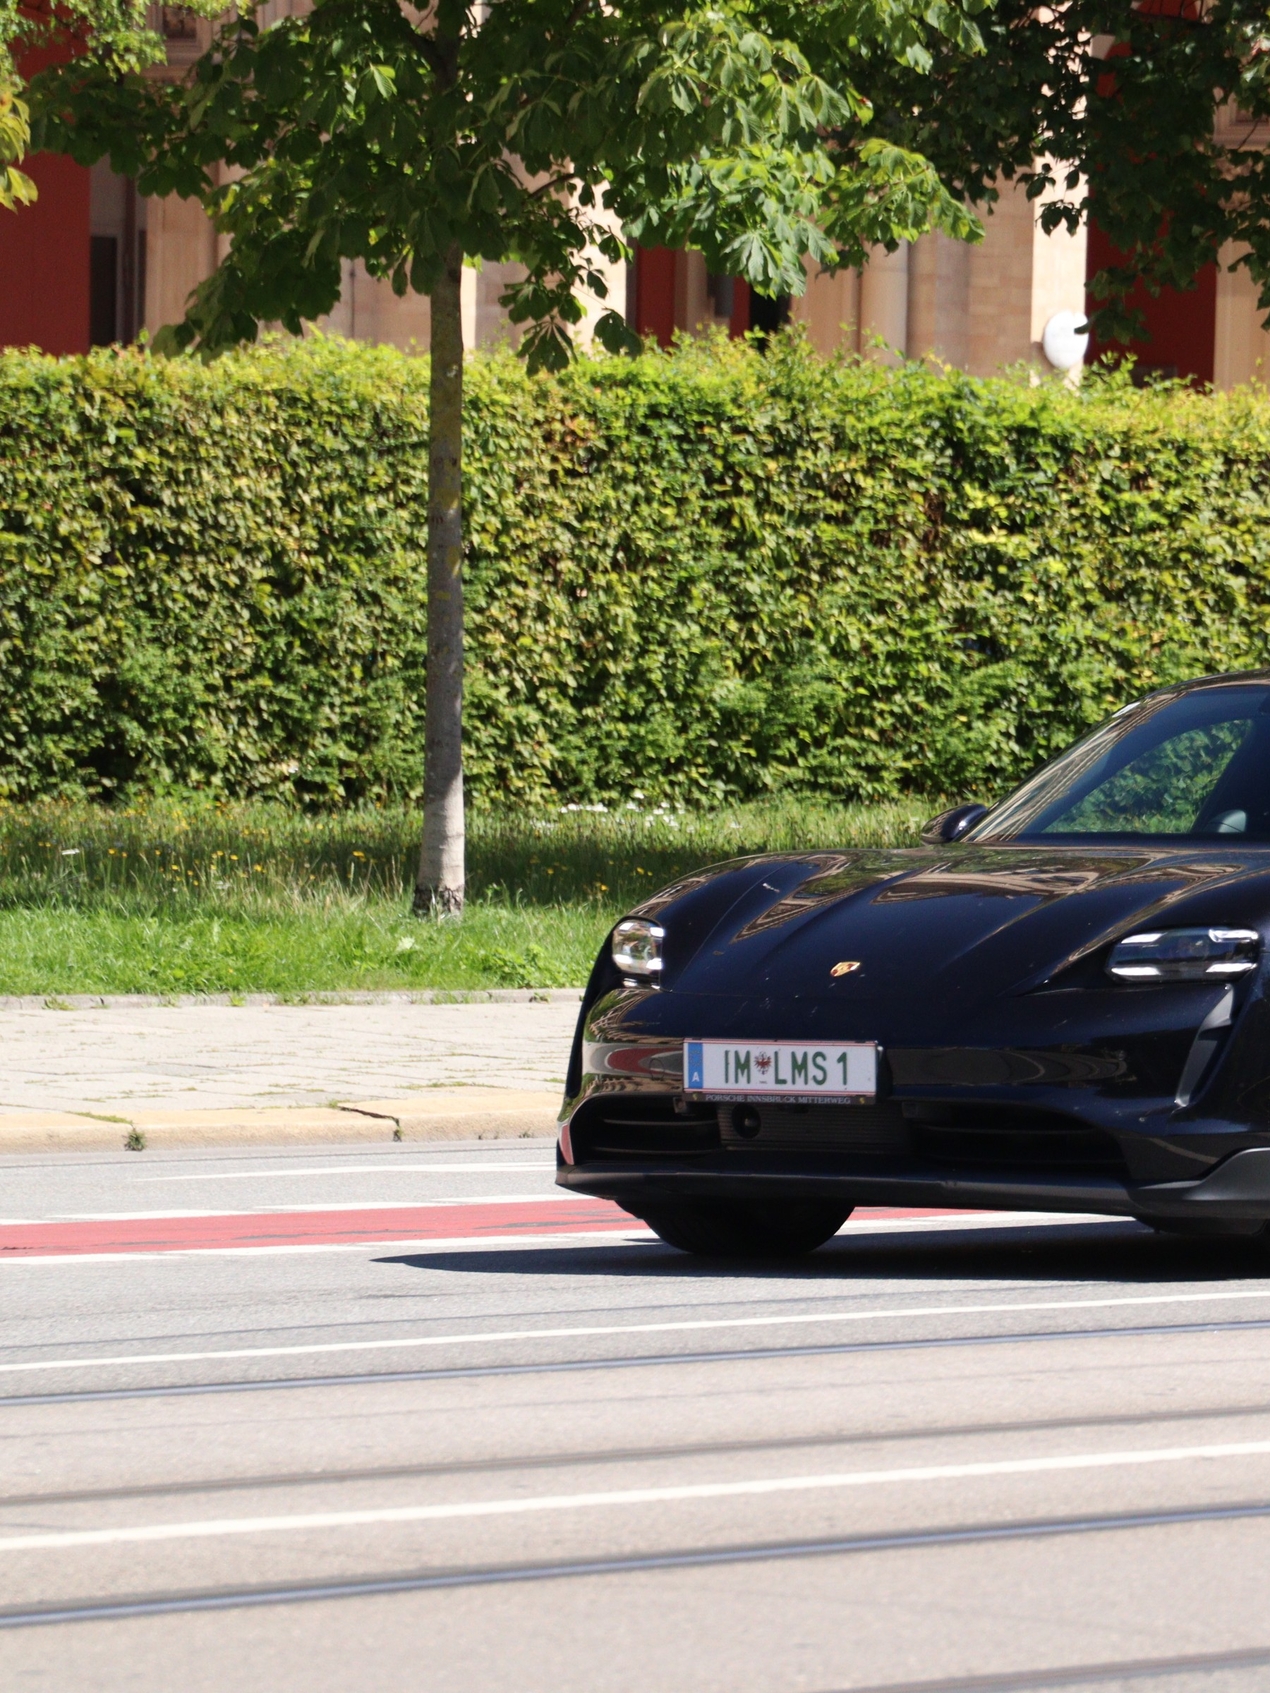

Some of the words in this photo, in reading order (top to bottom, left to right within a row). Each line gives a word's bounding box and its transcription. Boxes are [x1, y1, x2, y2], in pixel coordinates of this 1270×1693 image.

[724, 1050, 751, 1084] IM
[691, 1072, 700, 1082] A
[705, 1094, 745, 1103] PORSCHE
[798, 1096, 851, 1105] MITTERWEG
